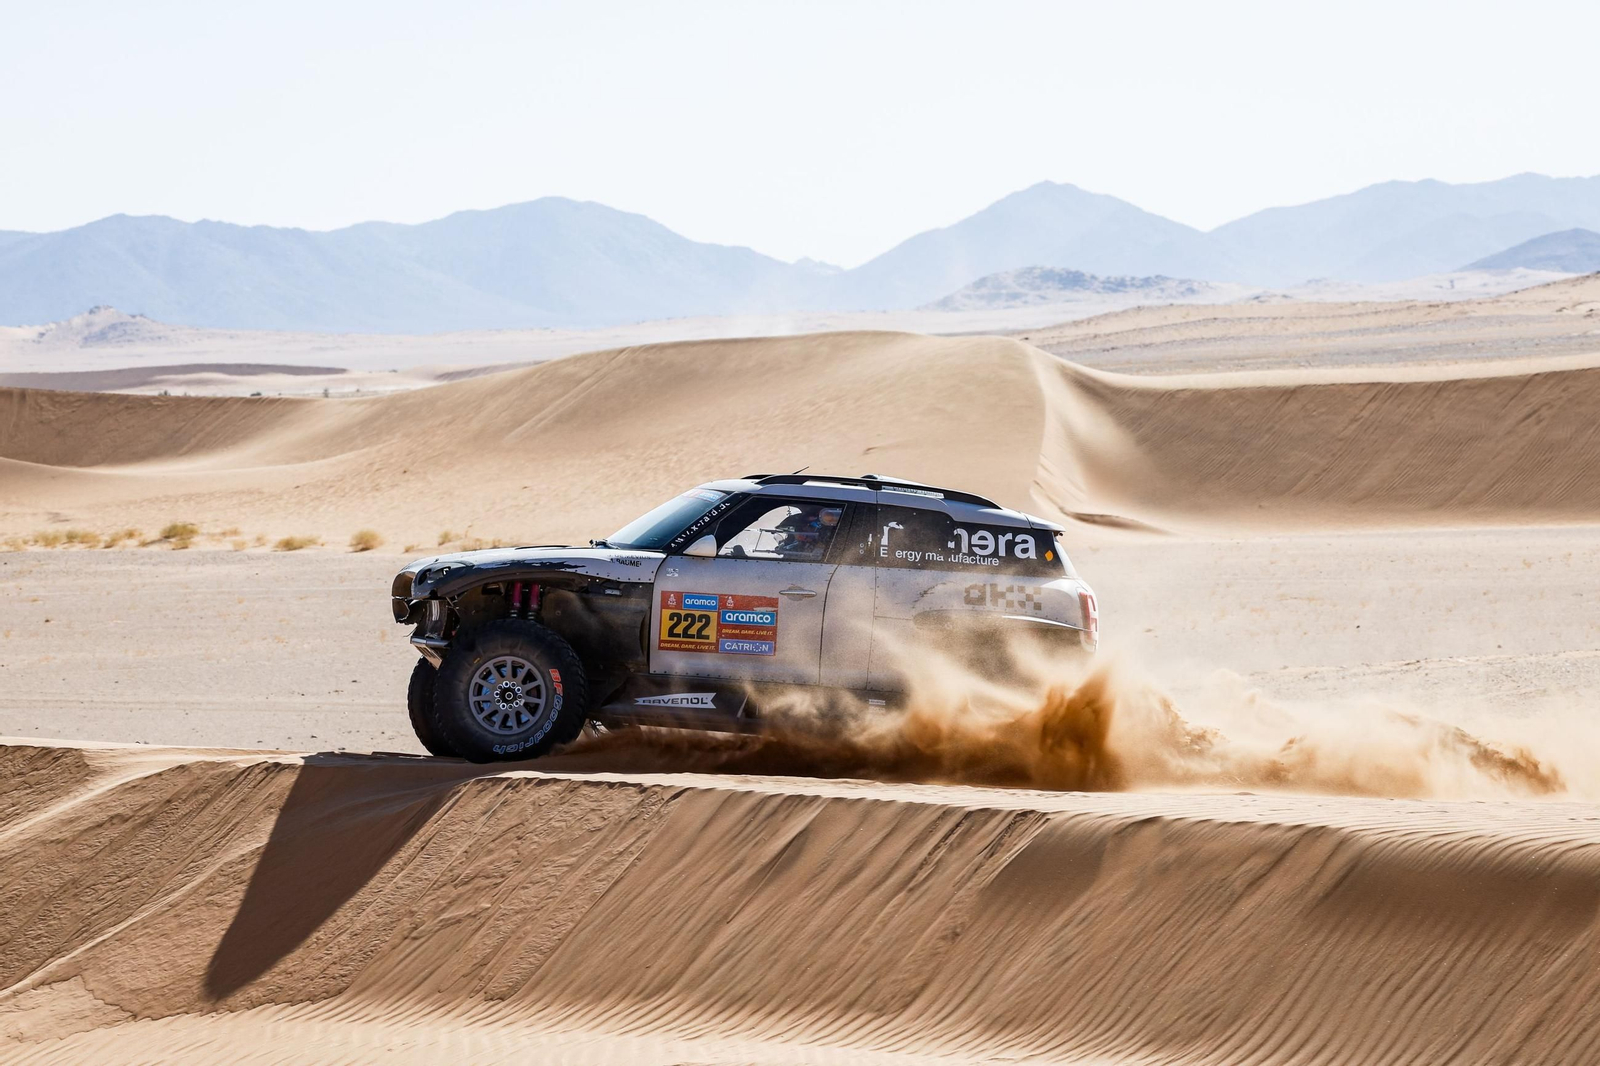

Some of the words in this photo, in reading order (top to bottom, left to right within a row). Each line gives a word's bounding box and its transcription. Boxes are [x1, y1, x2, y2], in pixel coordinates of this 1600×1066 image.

[880, 546, 922, 562] Eergy
[925, 551, 1000, 567] maufacture
[685, 598, 717, 607] aramco
[725, 612, 771, 623] aramco
[667, 612, 711, 641] 222
[724, 642, 769, 653] CATRION
[642, 697, 708, 705] RAVENOL
